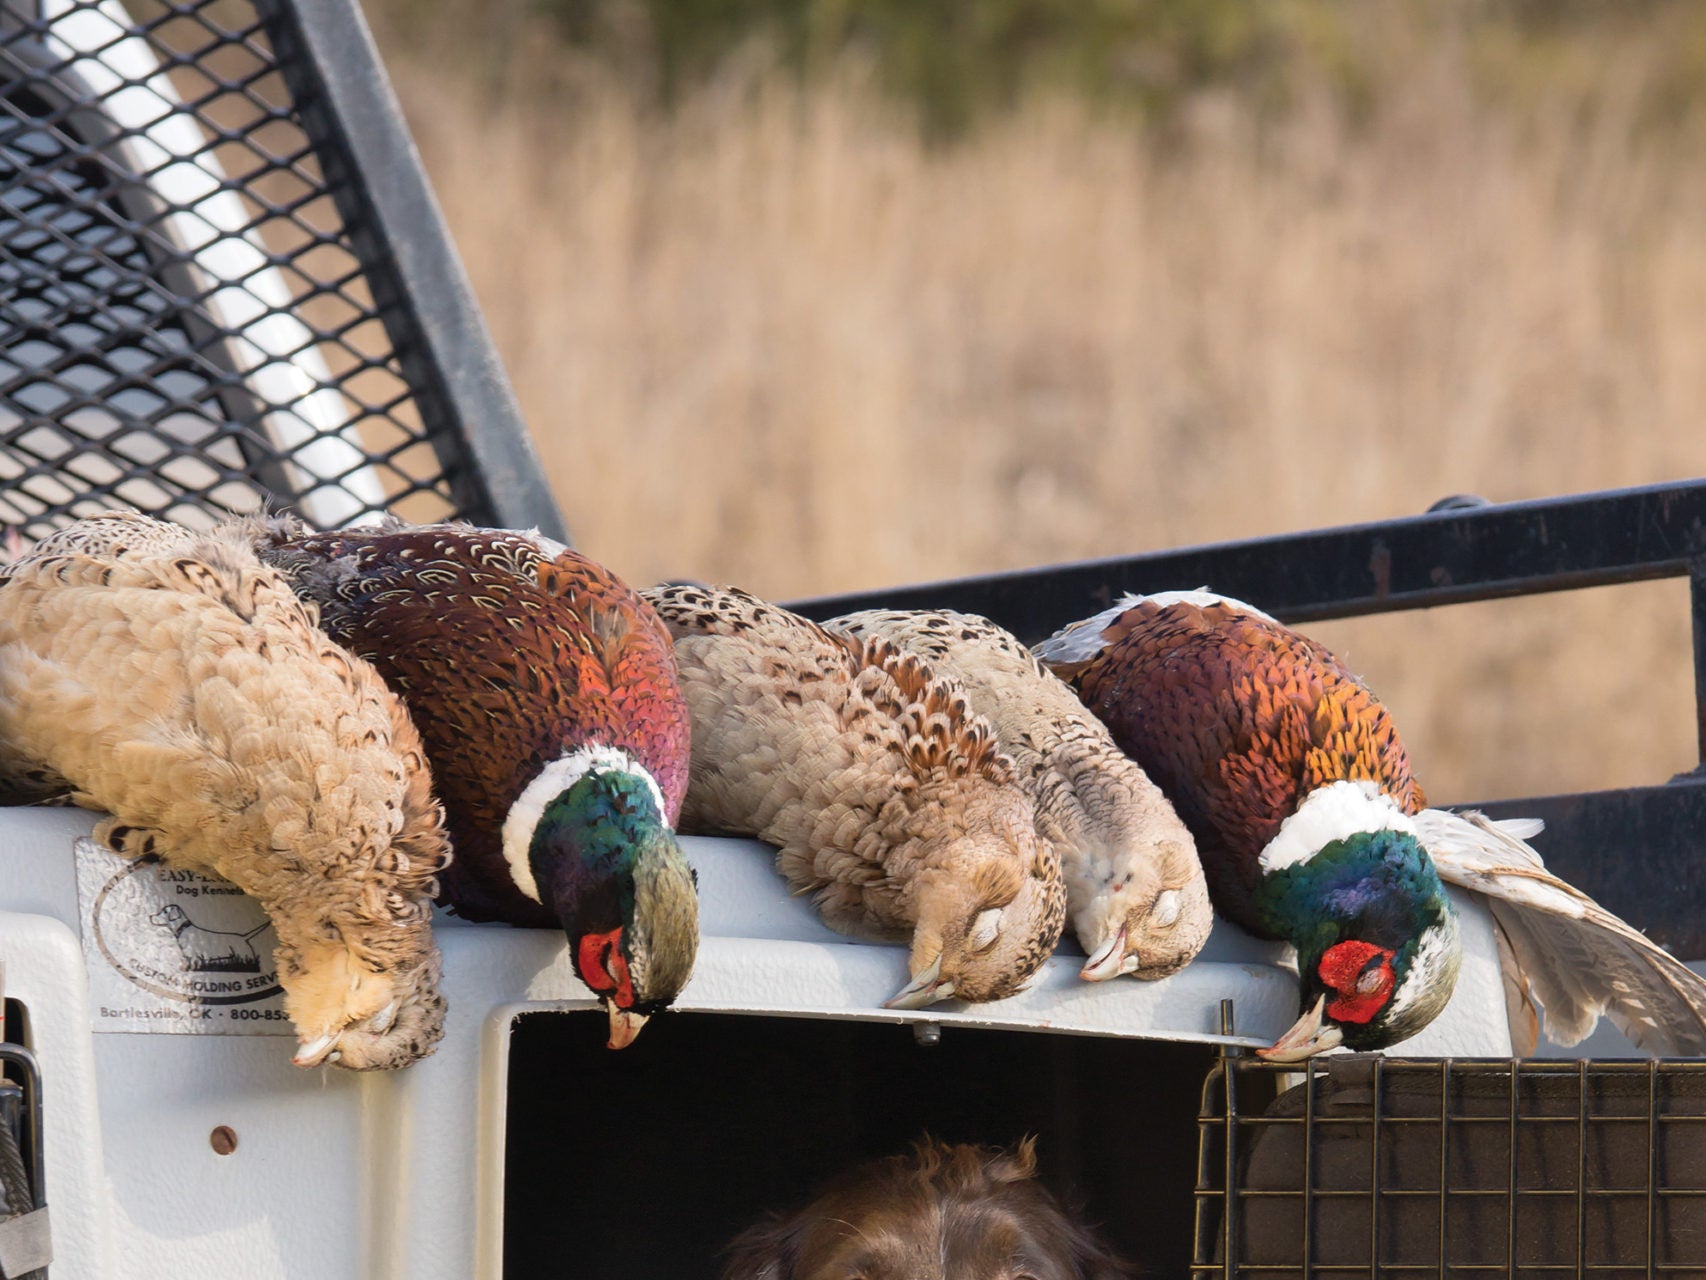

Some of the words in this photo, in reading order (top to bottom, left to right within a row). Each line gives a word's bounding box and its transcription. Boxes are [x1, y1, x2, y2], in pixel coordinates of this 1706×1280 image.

[176, 884, 199, 898] Dog
[129, 958, 178, 986] CUSTOM
[182, 979, 242, 993] MOLDING
[189, 1008, 213, 1020] OK
